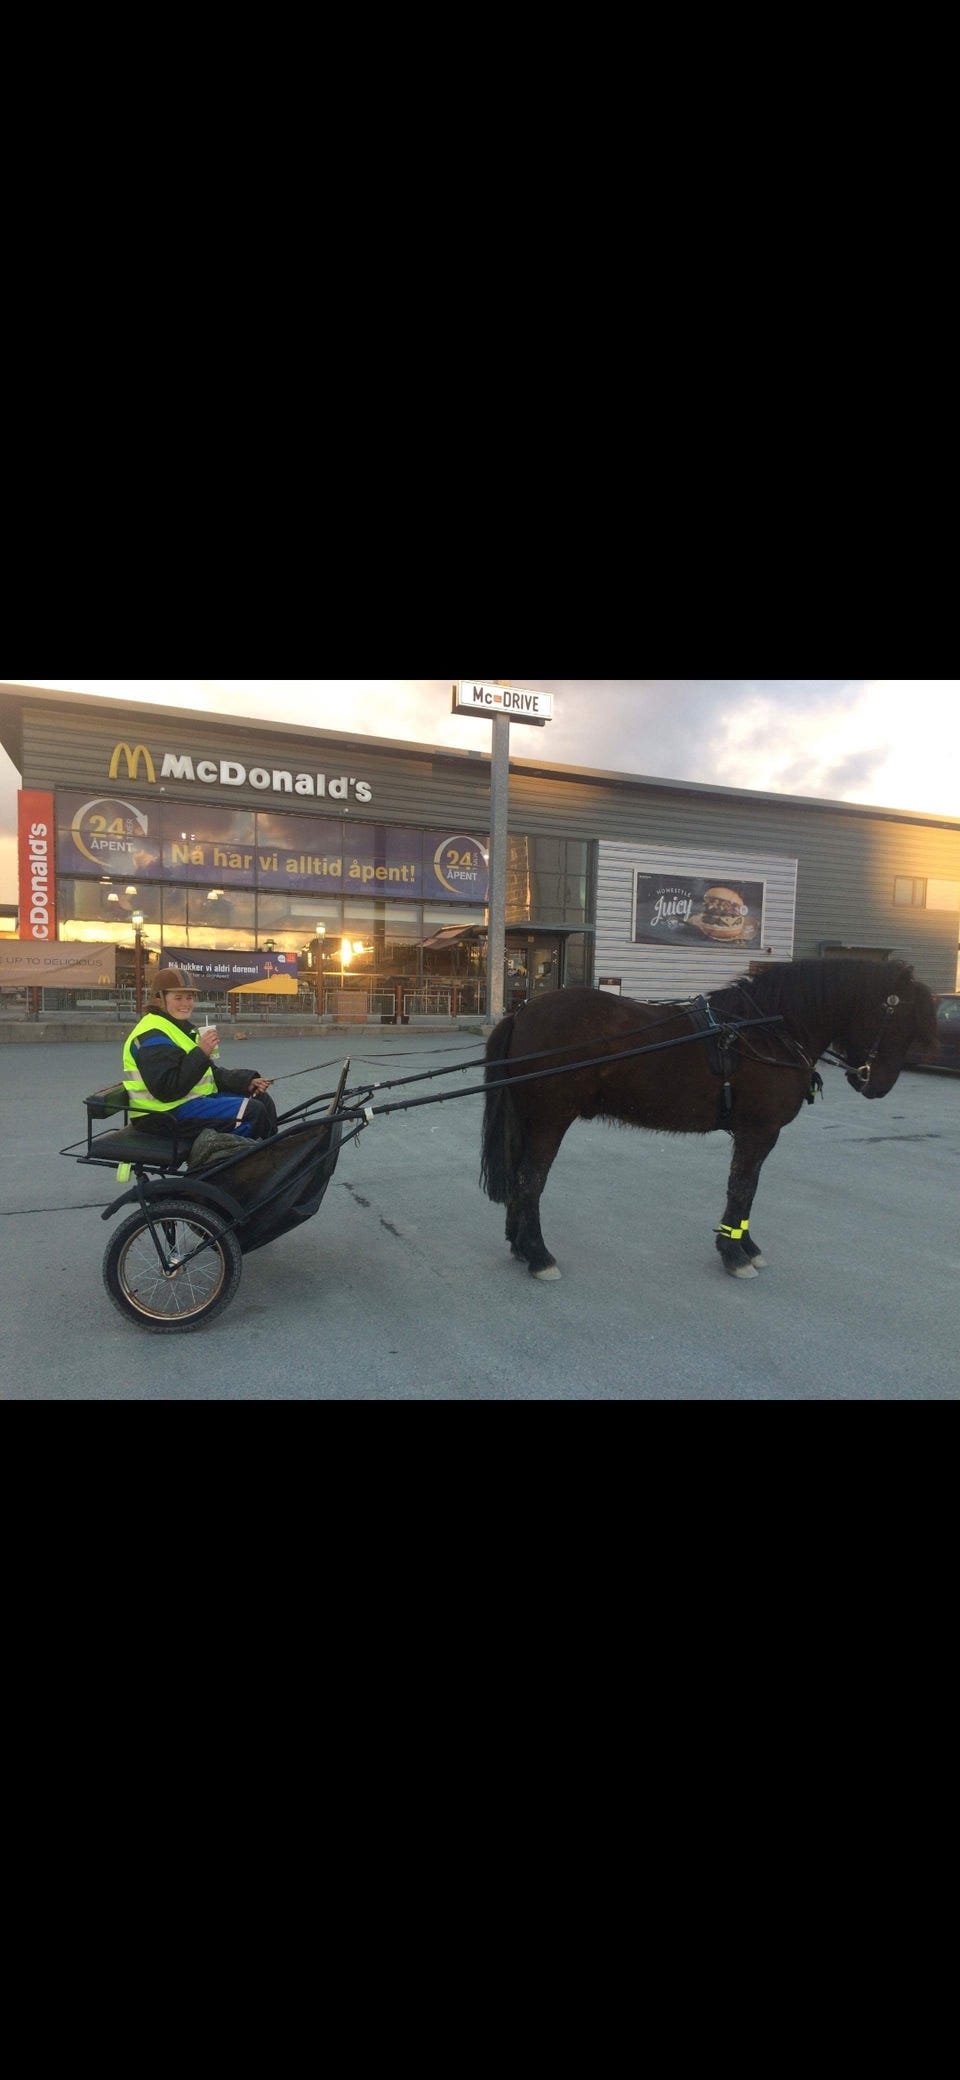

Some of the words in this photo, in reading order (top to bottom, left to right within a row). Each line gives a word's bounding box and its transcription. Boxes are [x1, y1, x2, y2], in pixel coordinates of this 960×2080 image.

[160, 753, 373, 803] McDonald's
[88, 814, 126, 840] 24
[90, 839, 134, 853] ÅPENT
[171, 843, 205, 866] Nå
[213, 848, 253, 870] har
[259, 853, 278, 872] vi
[286, 855, 342, 878] alltid
[349, 859, 417, 883] åpent!
[446, 849, 473, 870] 24
[28, 823, 49, 940] cDonald's
[447, 869, 478, 881] ÅPENT
[650, 895, 693, 926] Juicy
[6, 957, 22, 965] UP
[24, 957, 40, 966] TO
[43, 958, 103, 968] DELICIOUS
[205, 963, 212, 972] vi
[214, 964, 230, 973] aldri
